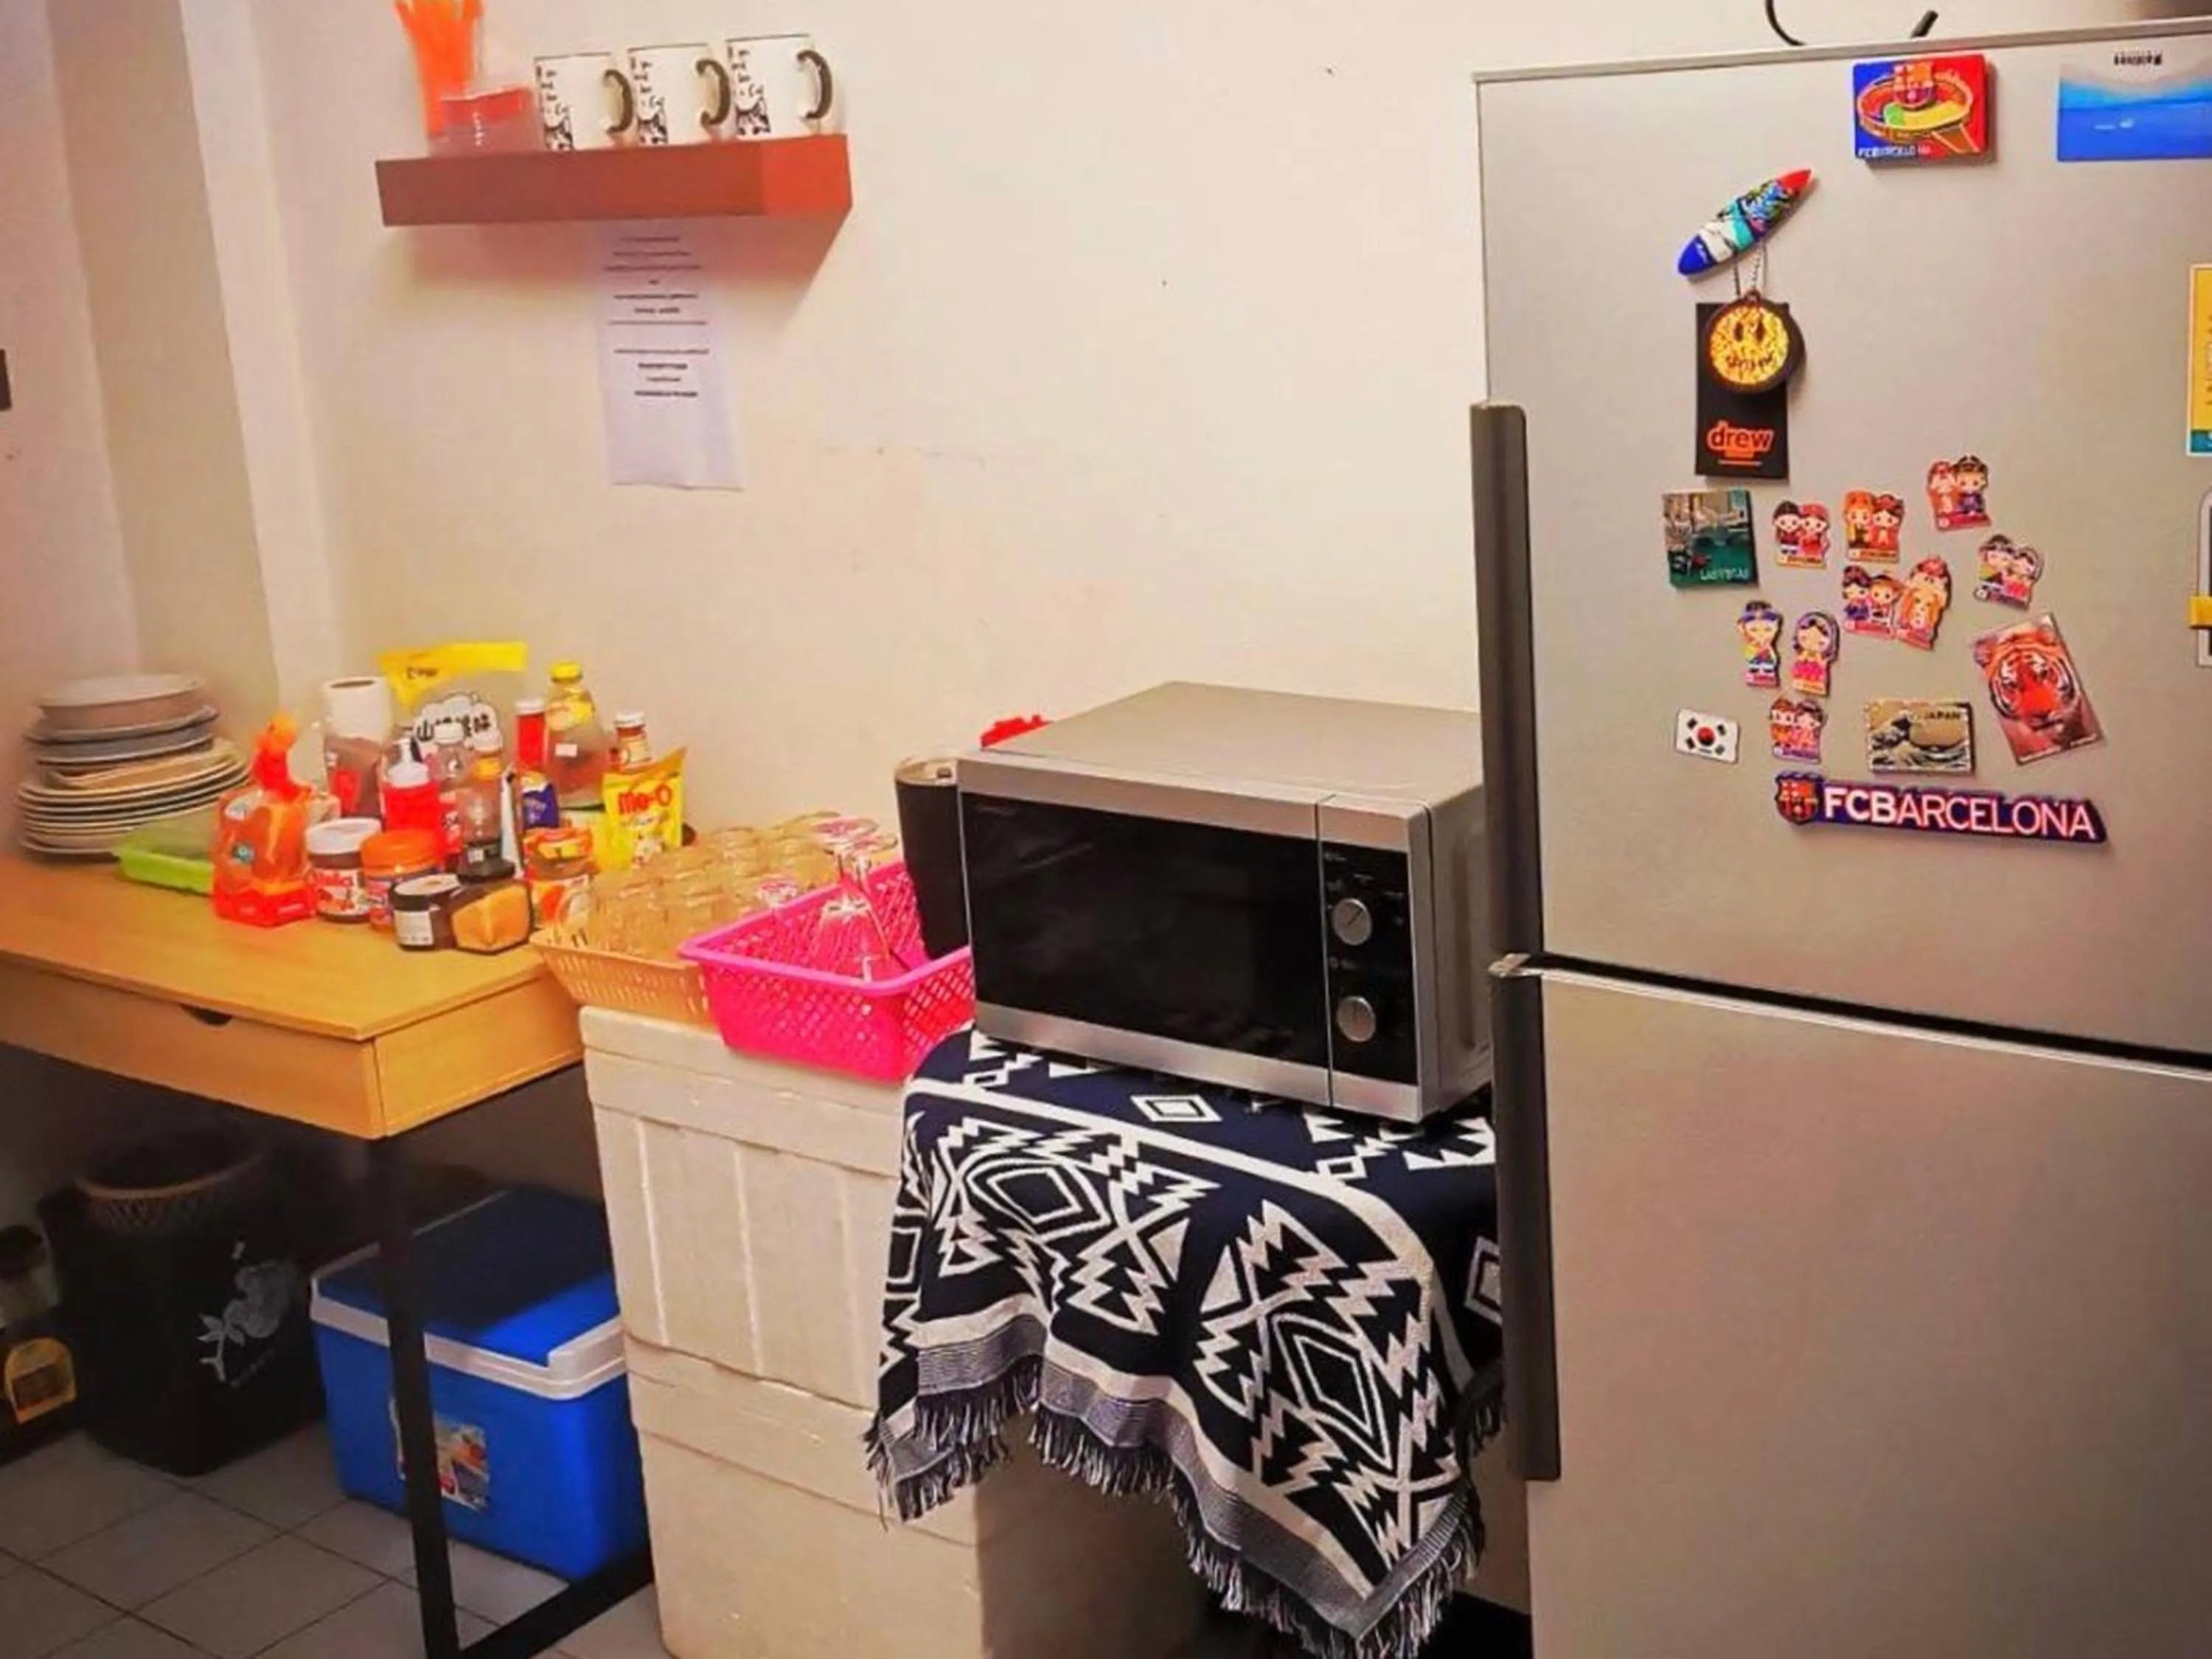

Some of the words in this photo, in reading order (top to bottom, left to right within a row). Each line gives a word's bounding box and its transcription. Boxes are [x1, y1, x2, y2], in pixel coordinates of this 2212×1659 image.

[1709, 423, 1773, 451] drew
[1924, 710, 1961, 720] JAPAN
[1823, 786, 2097, 840] FCBARCELONA
